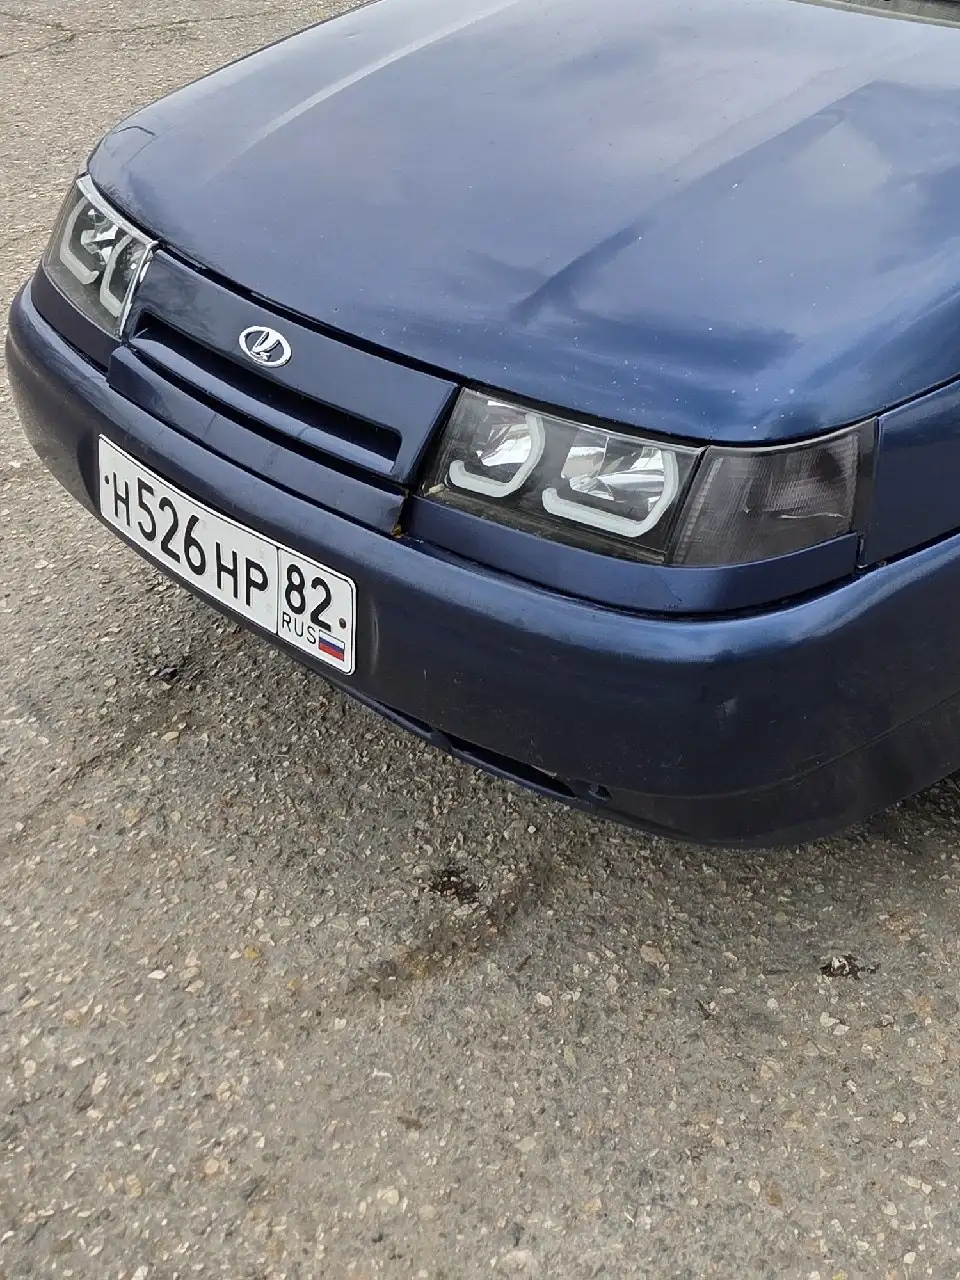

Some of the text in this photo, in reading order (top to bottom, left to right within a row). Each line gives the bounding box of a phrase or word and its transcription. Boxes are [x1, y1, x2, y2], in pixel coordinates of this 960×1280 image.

[112, 471, 333, 633] Н526НР 82
[281, 611, 317, 645] RUS
